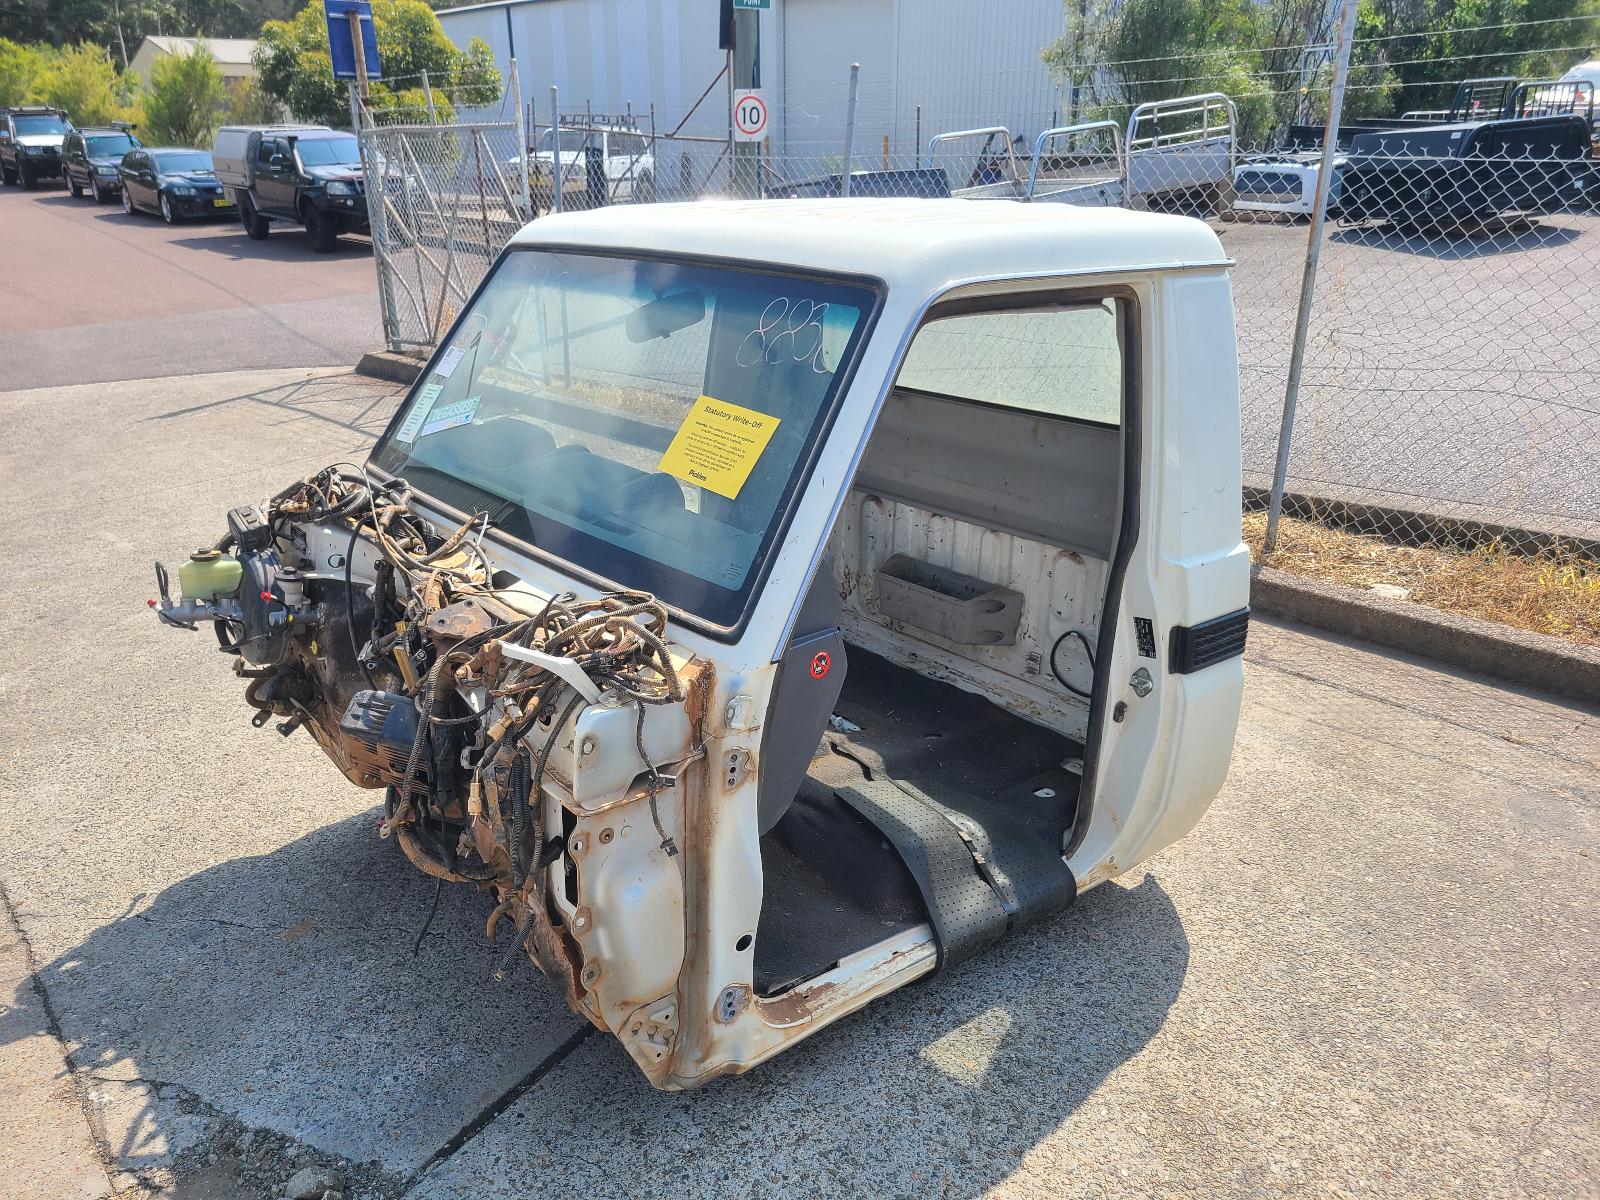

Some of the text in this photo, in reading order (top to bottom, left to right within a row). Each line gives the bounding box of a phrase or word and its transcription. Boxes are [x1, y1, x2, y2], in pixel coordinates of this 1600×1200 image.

[741, 106, 760, 125] 10
[703, 405, 764, 429] Statutory Write-Off
[688, 469, 708, 481] Pickles
